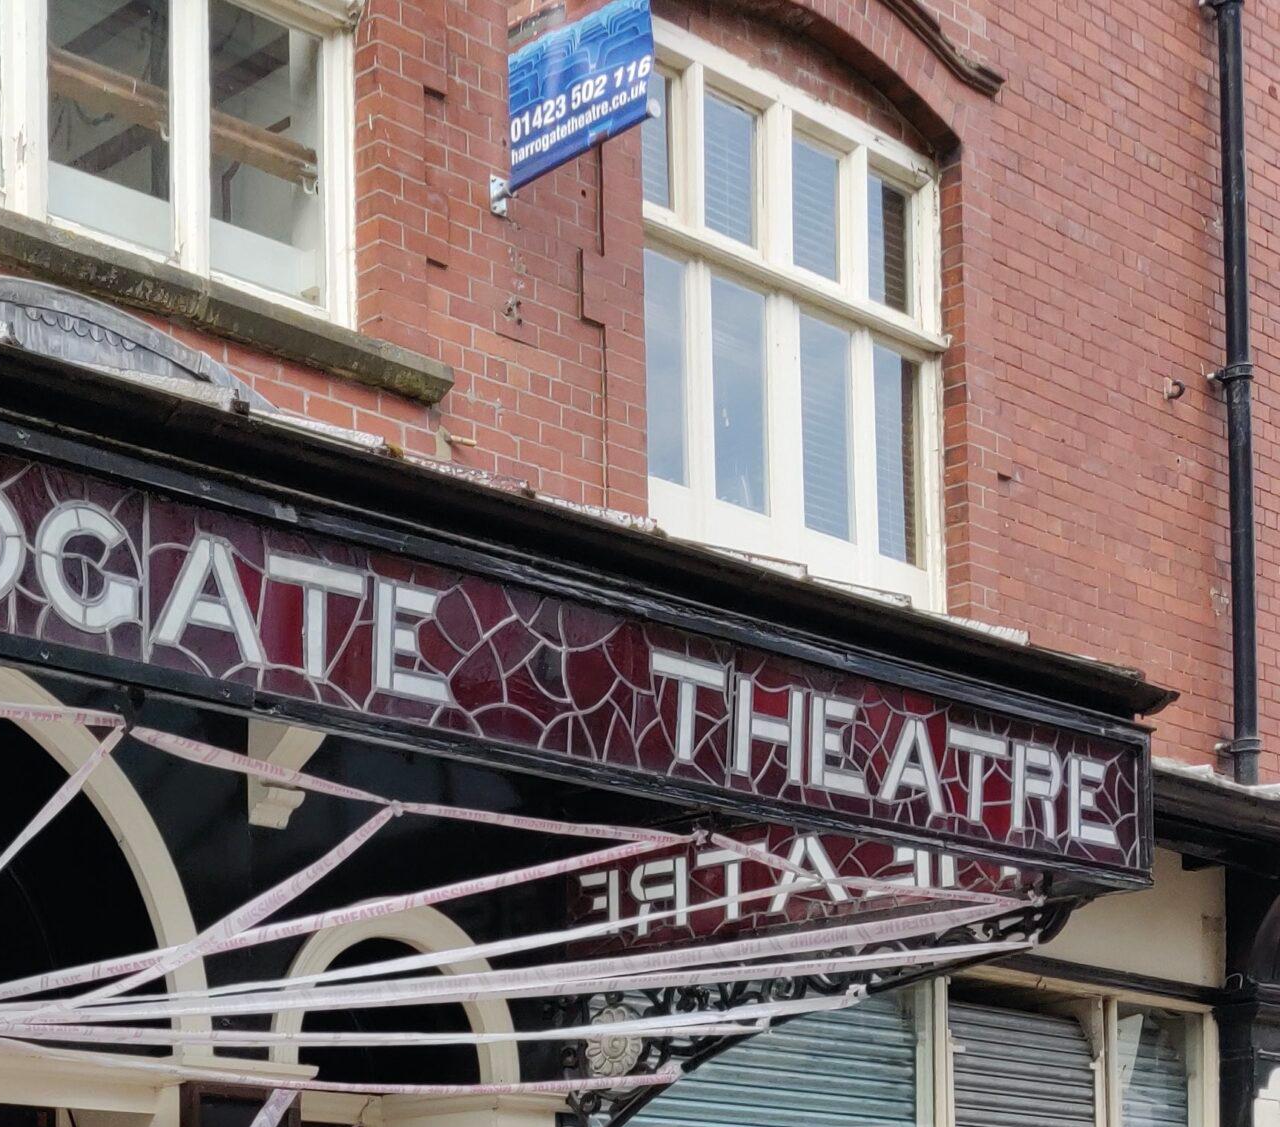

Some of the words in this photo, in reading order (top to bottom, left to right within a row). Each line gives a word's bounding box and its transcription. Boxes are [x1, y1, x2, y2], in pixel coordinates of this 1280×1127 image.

[511, 94, 566, 143] 01423
[572, 74, 608, 110] 502
[614, 55, 651, 88] 116
[511, 81, 647, 166] harrogatetheatre.co.uk
[649, 648, 1118, 847] THEATRE
[331, 905, 395, 925] THEATRE
